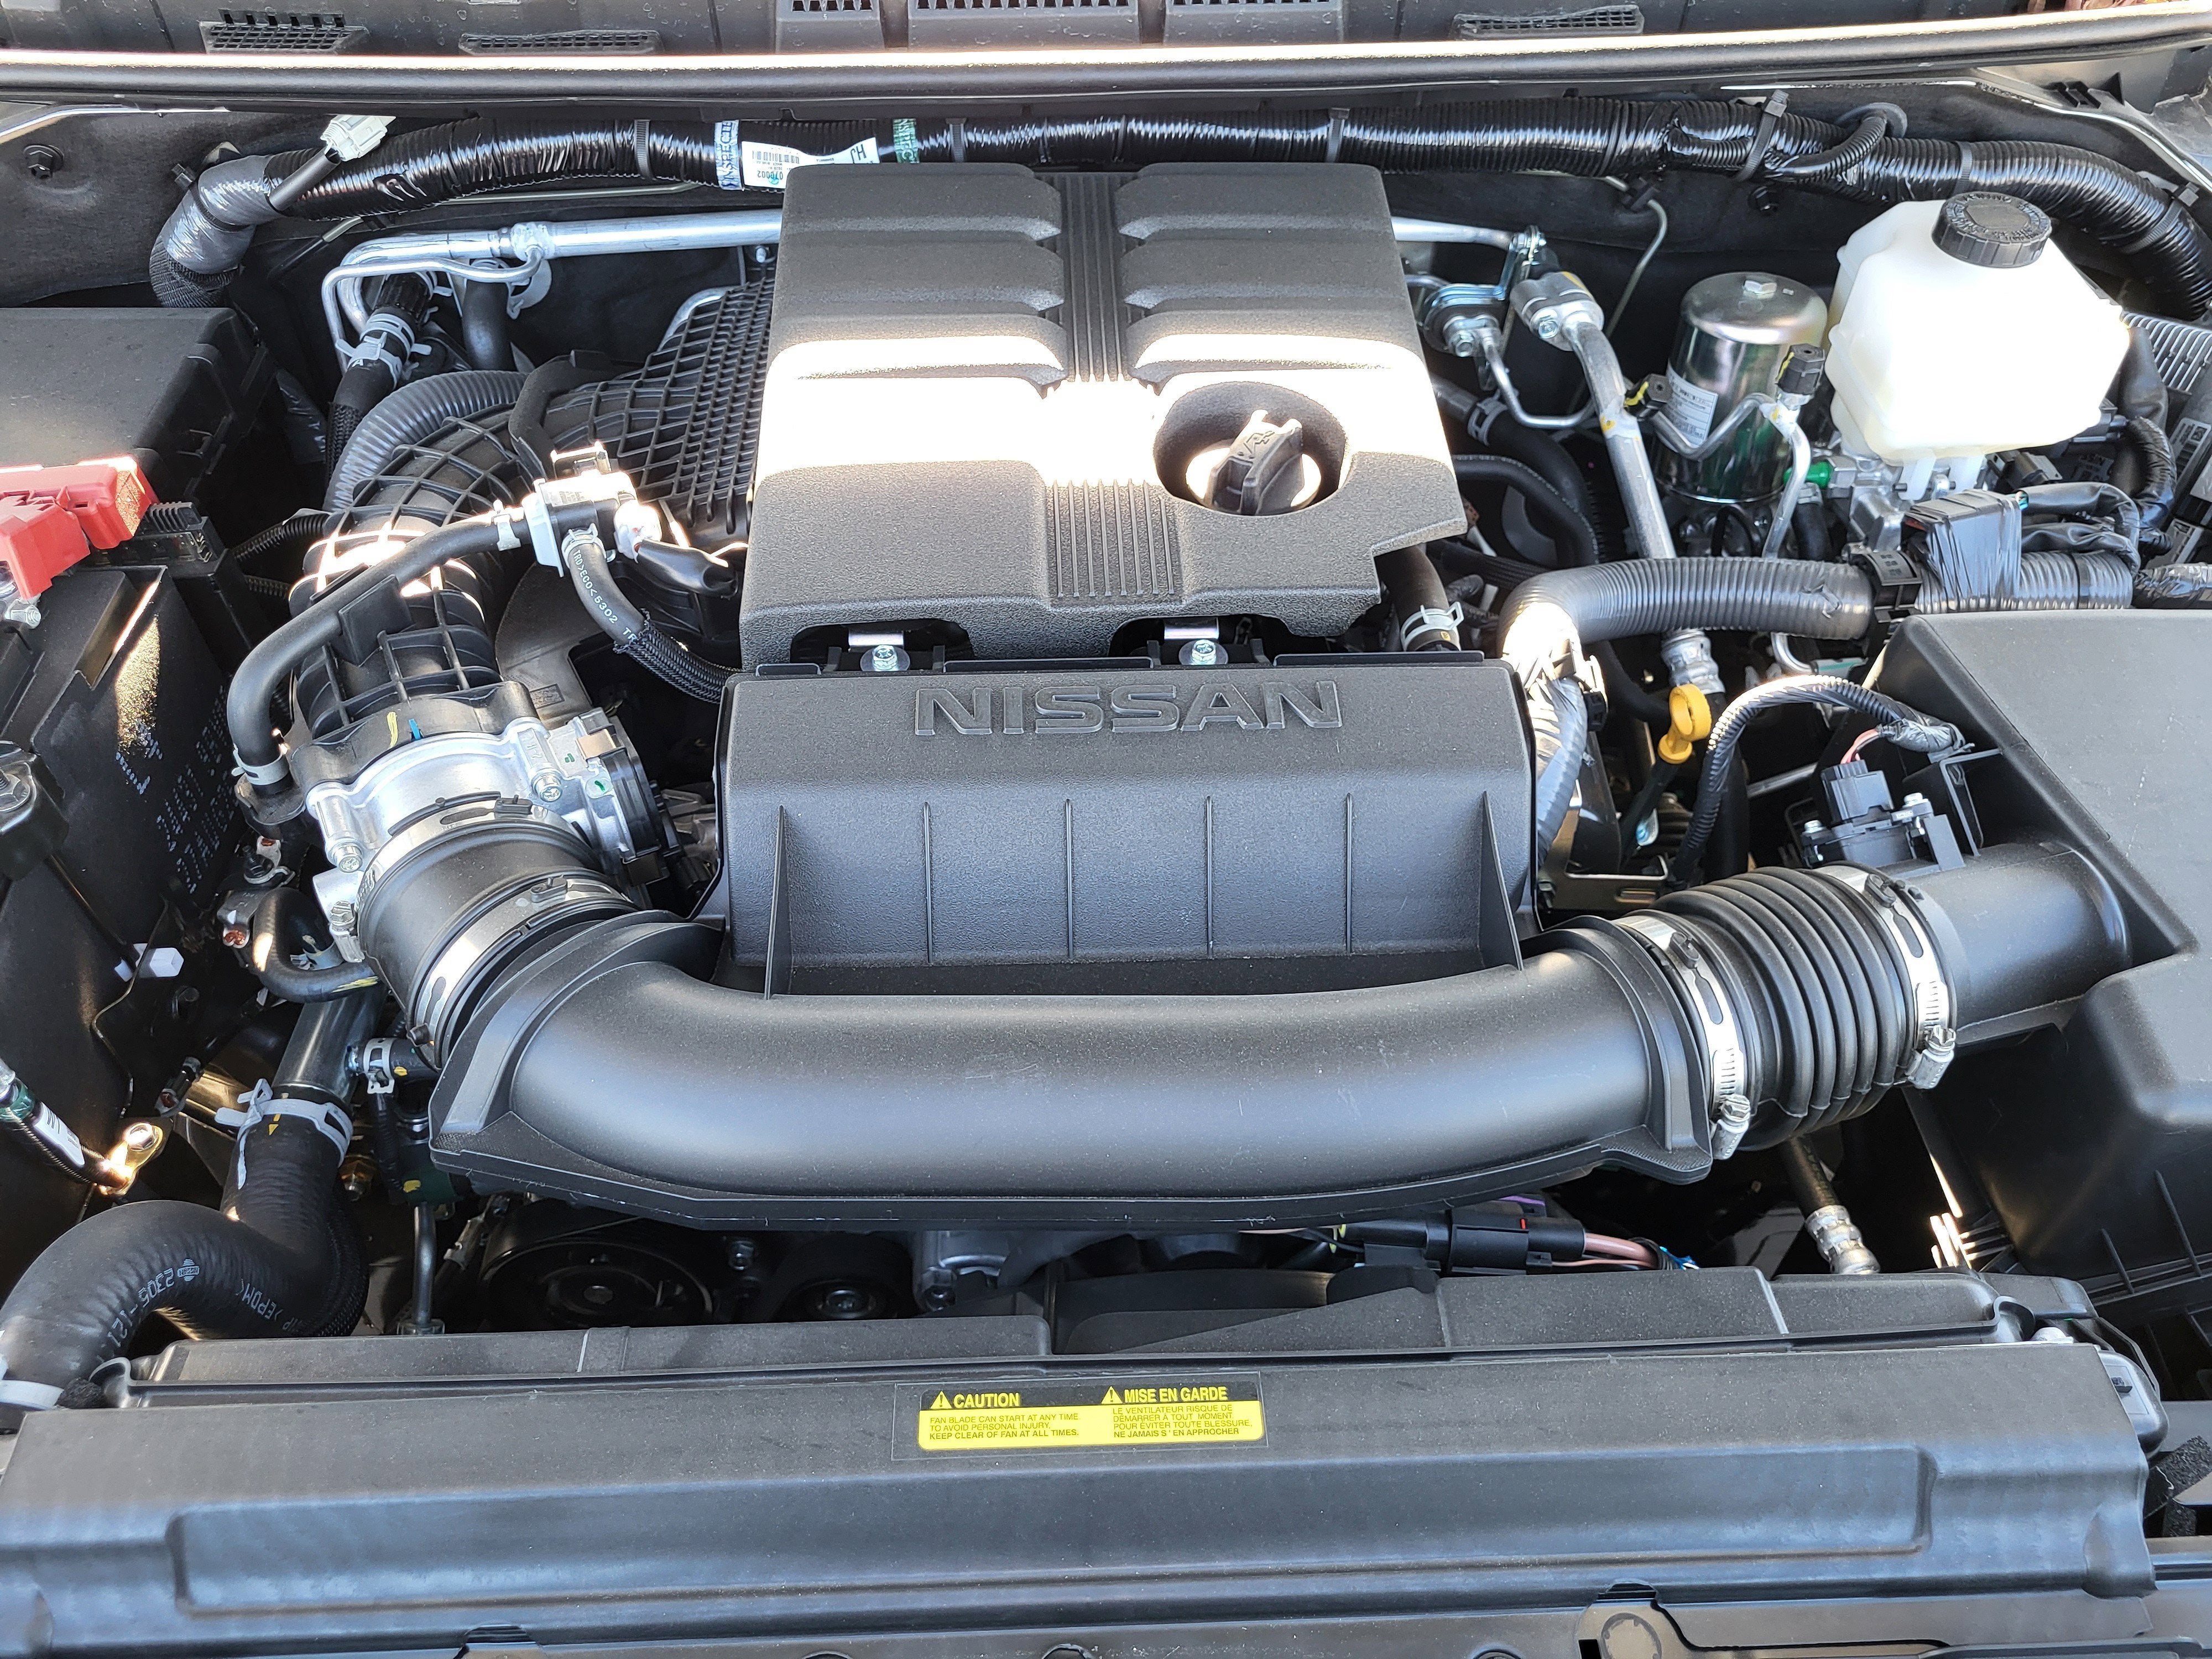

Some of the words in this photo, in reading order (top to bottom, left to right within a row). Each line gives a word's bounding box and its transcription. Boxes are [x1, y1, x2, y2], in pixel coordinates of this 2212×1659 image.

[914, 680, 1343, 736] NISSAN
[953, 1392, 1020, 1408] CAUTION
[1124, 1389, 1156, 1403] MISE
[1159, 1387, 1178, 1402] EN
[1180, 1386, 1228, 1401] GARDE
[1125, 1406, 1183, 1414] VENTILATEUR
